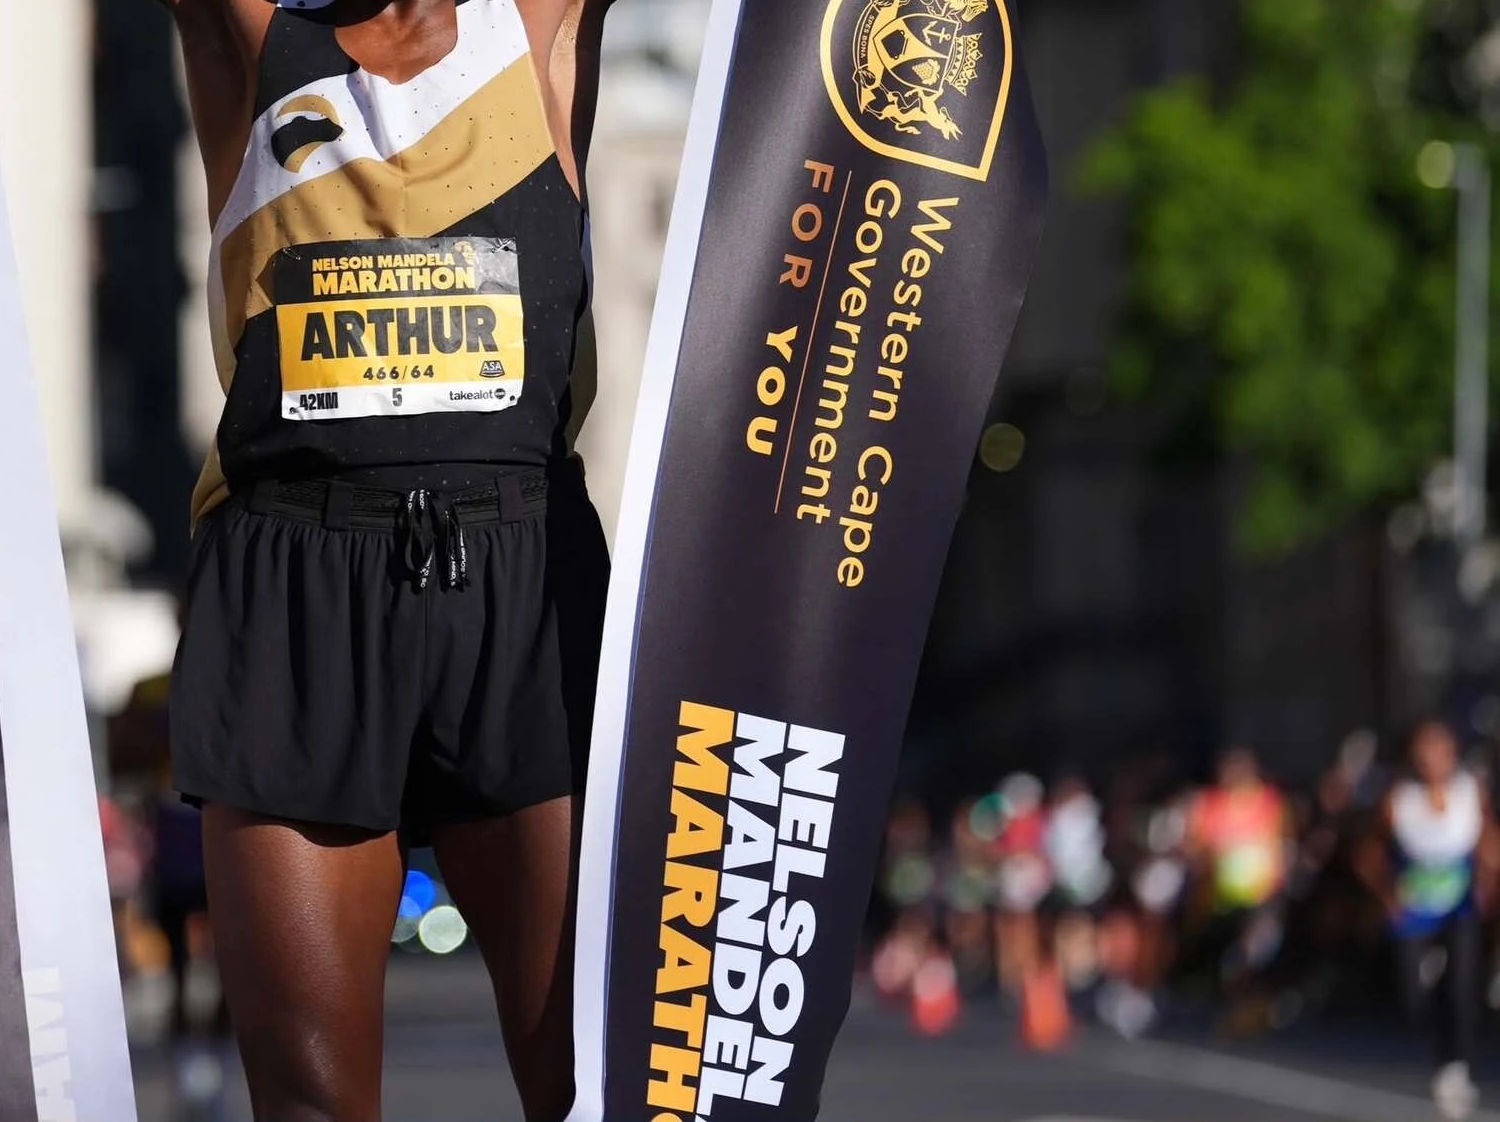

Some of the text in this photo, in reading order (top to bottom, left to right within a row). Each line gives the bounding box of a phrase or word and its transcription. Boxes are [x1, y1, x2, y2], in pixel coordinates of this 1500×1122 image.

[312, 253, 454, 271] NELSON MANDELA
[313, 267, 476, 296] MARATHON
[301, 305, 499, 361] ARTHUR
[746, 159, 834, 456] FOR YOU
[363, 365, 434, 381] 466/64
[482, 362, 502, 371] ASA
[797, 179, 902, 524] Government
[392, 388, 403, 407] 5
[449, 390, 493, 400] takealot
[837, 195, 960, 587] Western Cape
[646, 700, 735, 1122] MARATH
[695, 713, 788, 1122] MANDEL
[743, 724, 846, 1107] NELSON
